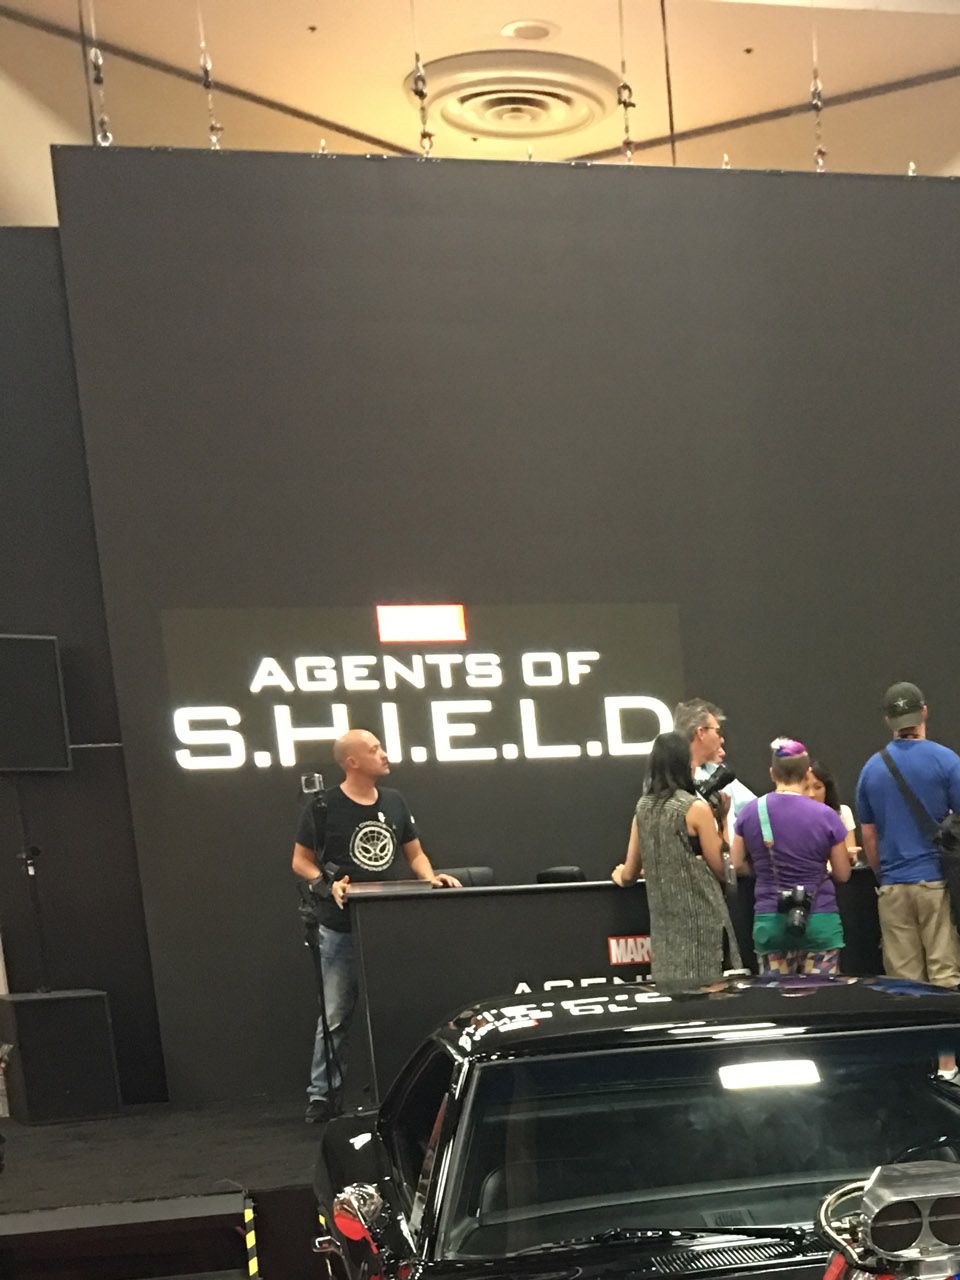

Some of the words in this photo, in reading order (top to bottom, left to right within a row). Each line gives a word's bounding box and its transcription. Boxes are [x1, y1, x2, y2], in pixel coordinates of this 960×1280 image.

[248, 652, 503, 694] AGENTS
[520, 650, 601, 687] OF
[609, 937, 652, 964] MAR
